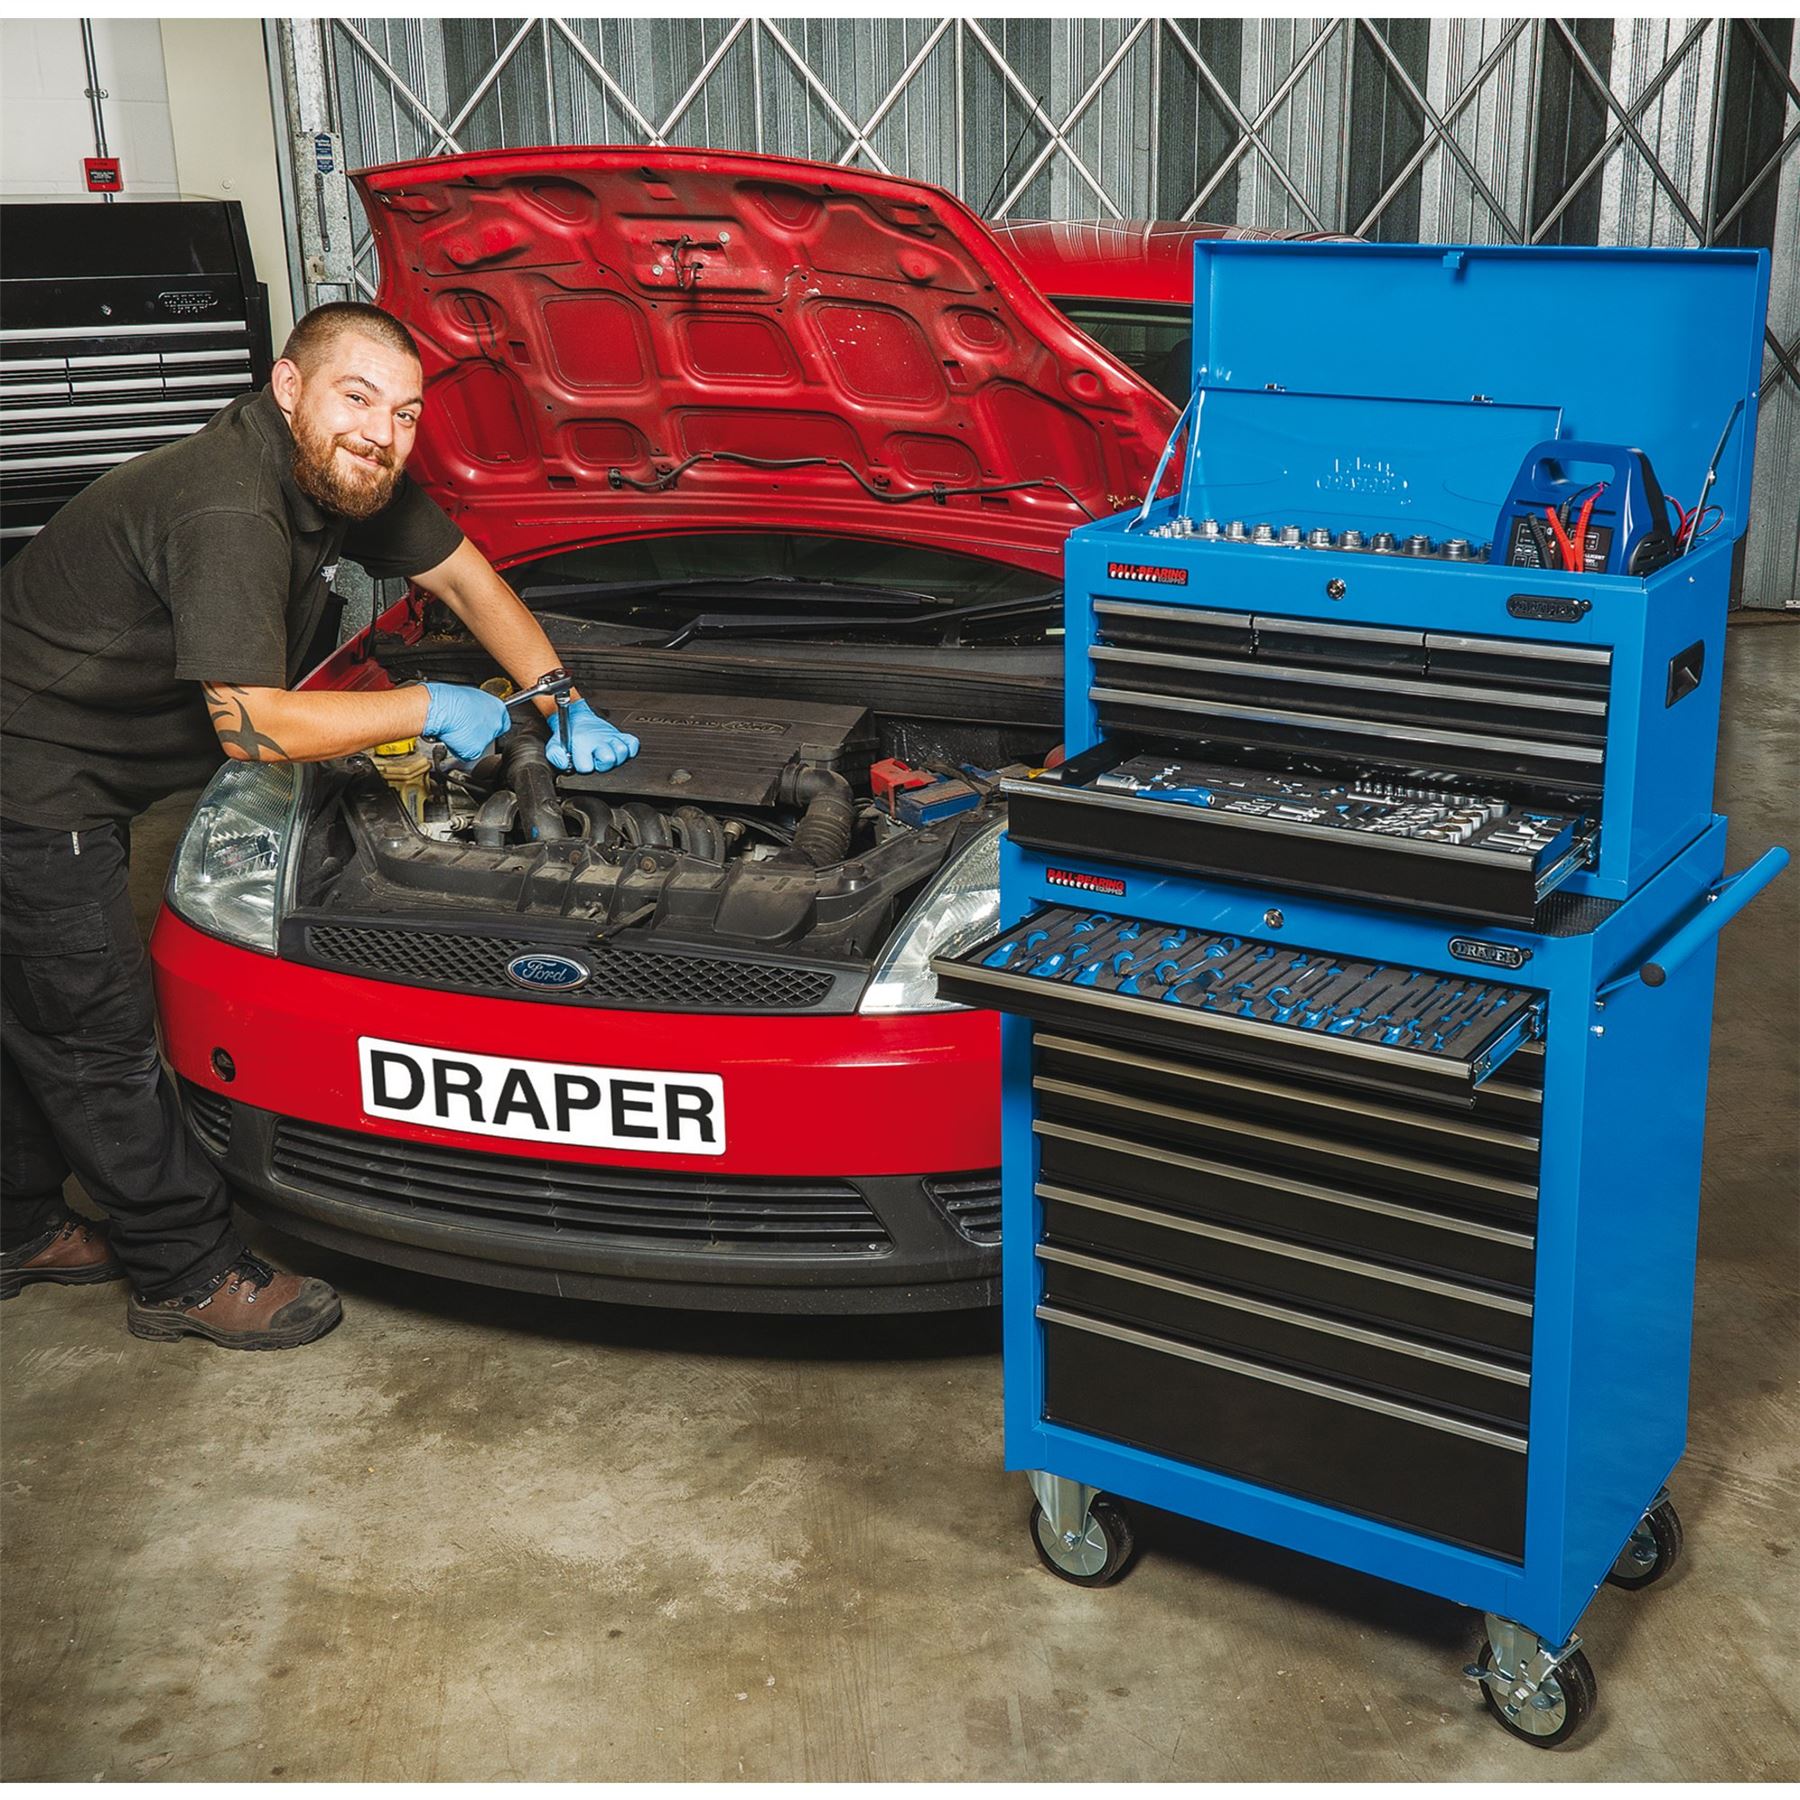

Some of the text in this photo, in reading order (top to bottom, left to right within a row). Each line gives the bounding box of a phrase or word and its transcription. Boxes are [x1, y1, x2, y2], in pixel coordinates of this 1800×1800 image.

[1456, 942, 1517, 964] DRAPER
[522, 960, 568, 982] Ford
[370, 1049, 717, 1143] DRAPER
